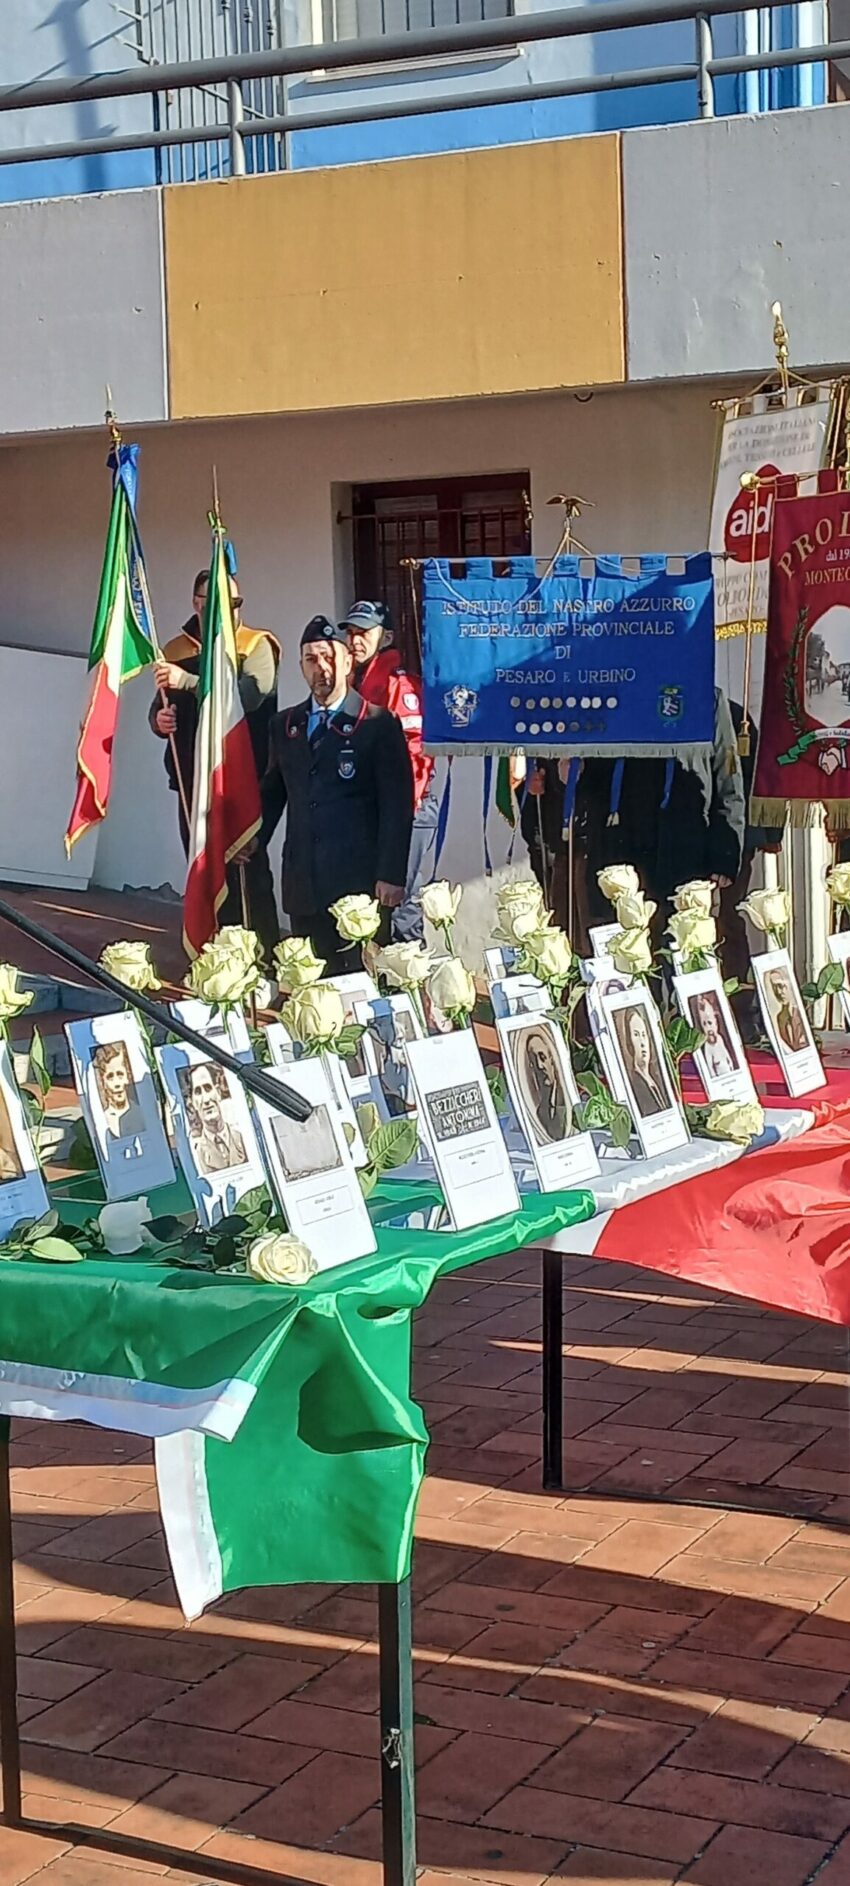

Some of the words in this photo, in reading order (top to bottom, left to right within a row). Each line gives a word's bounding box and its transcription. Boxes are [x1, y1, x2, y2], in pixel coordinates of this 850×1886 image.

[441, 600, 512, 616] ISTITUTO
[516, 599, 547, 615] DEL
[553, 598, 614, 614] NASTRO
[620, 596, 695, 613] AZZURRO
[458, 622, 567, 638] FEDERAZIONE
[572, 621, 674, 637] PROVINCIALE
[555, 645, 571, 659] DI
[495, 668, 555, 684] PESARO
[578, 668, 636, 683] URBINO
